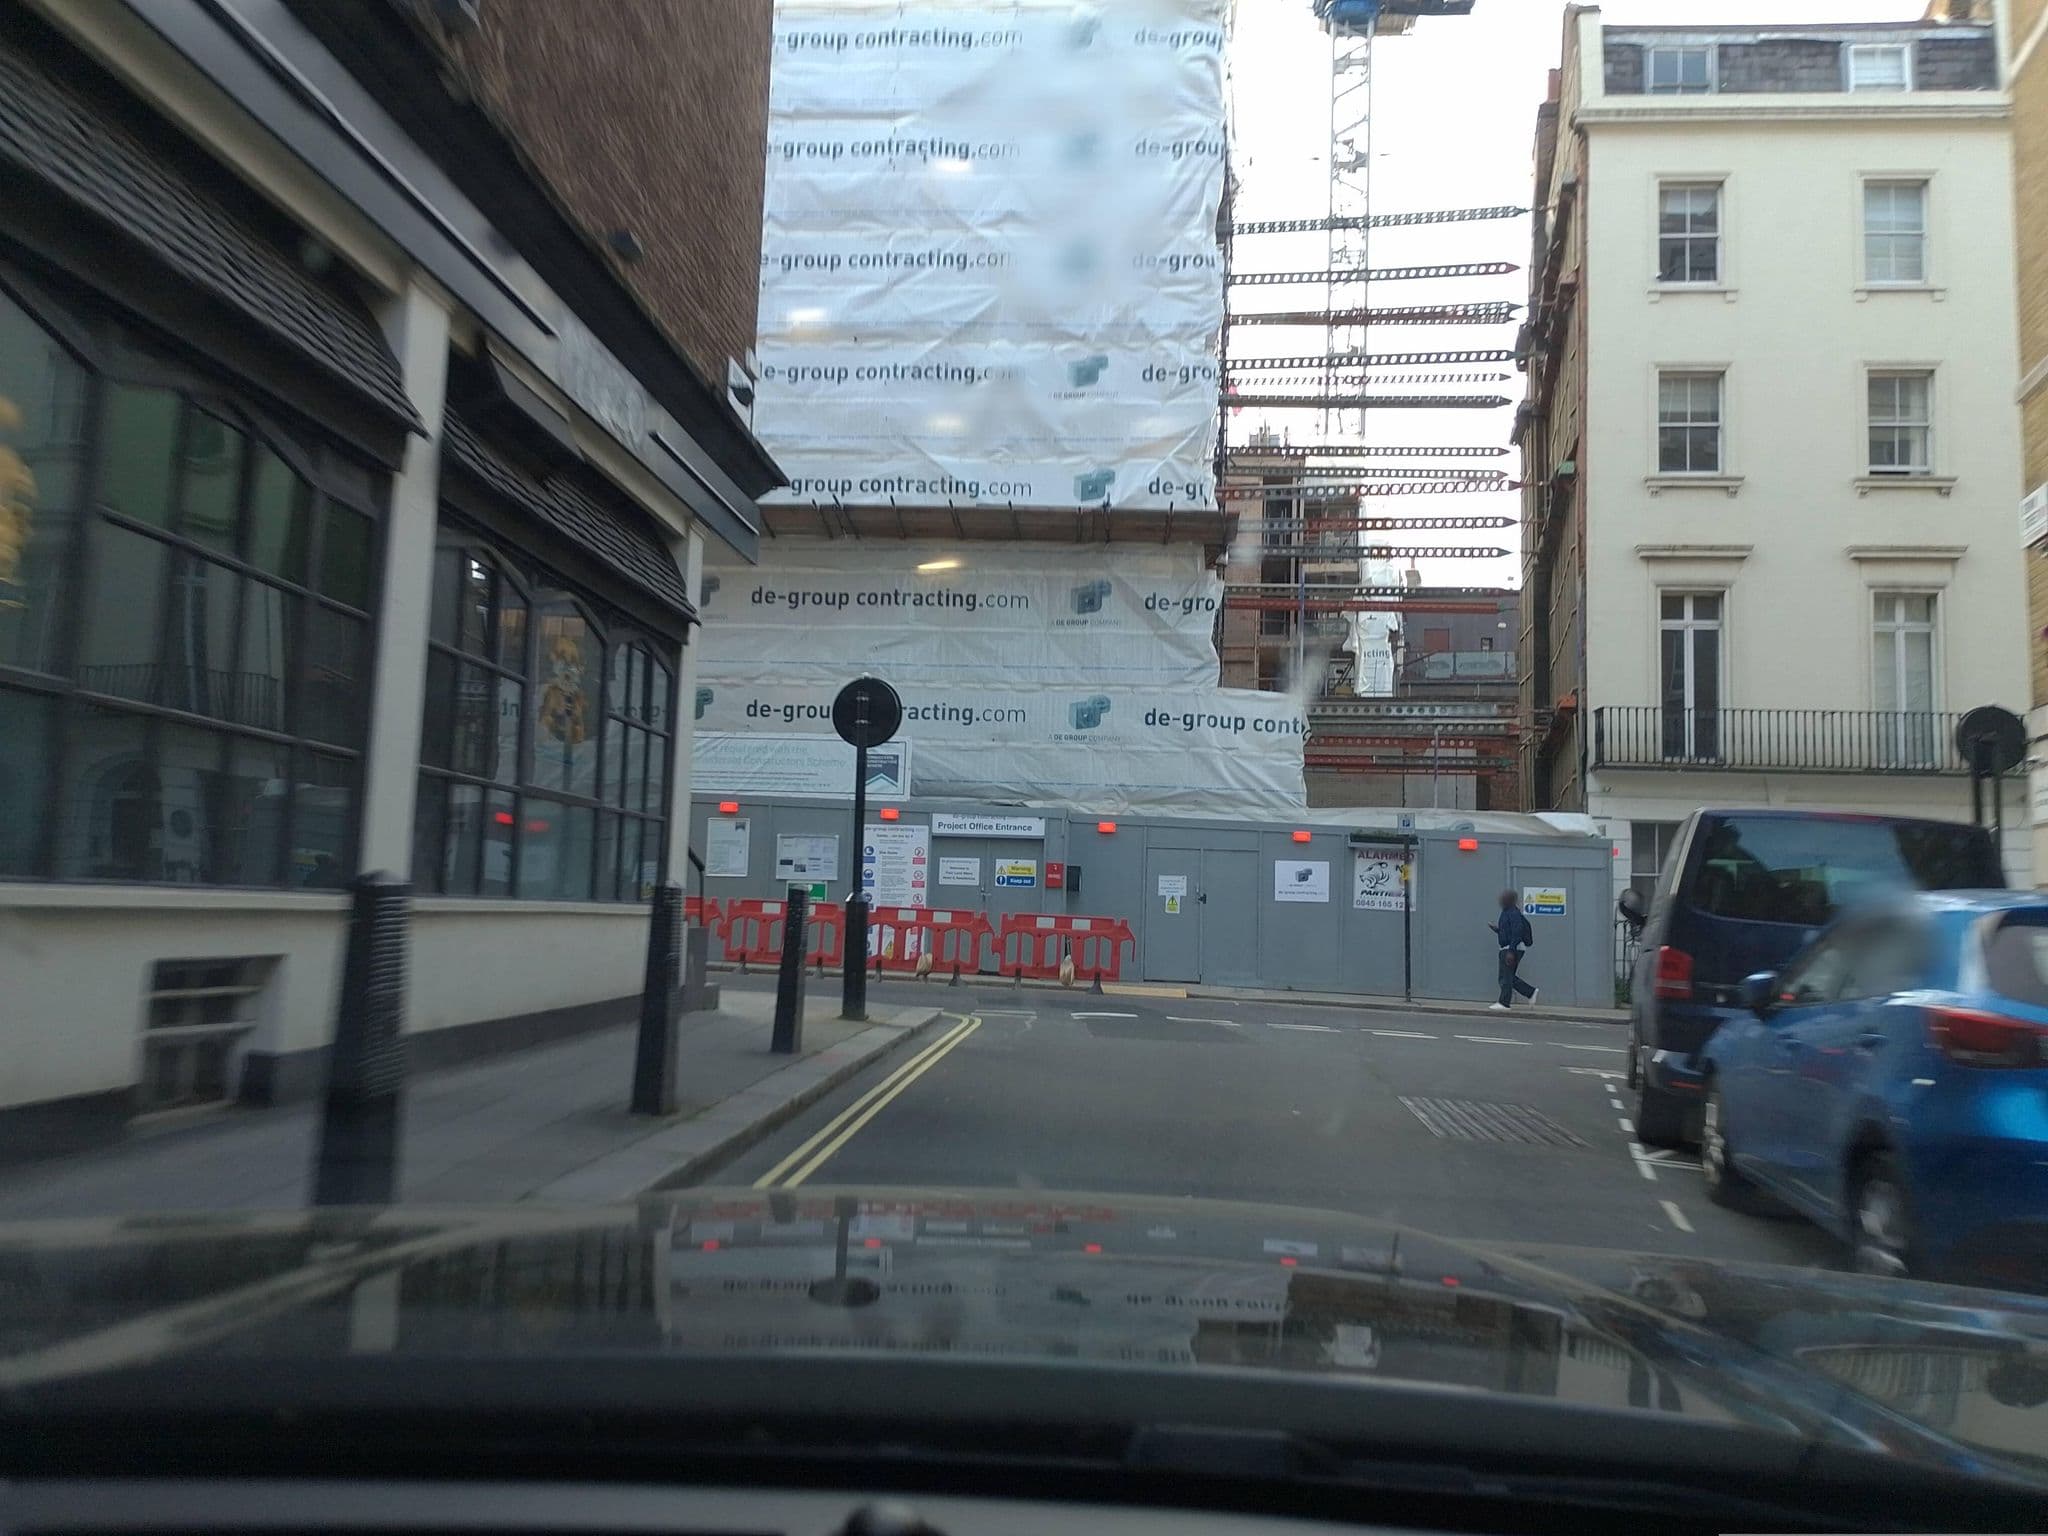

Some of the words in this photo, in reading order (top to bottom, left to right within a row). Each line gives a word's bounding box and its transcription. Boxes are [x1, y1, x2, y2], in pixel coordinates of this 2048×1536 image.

[1142, 364, 1216, 384] de-gro
[860, 476, 1032, 498] contracting.com
[751, 585, 850, 611] de-group
[857, 588, 1029, 612] contracting.com
[1144, 708, 1246, 734] de-group
[938, 821, 967, 831] Project
[969, 822, 993, 831] Office
[995, 823, 1033, 832] Entrance
